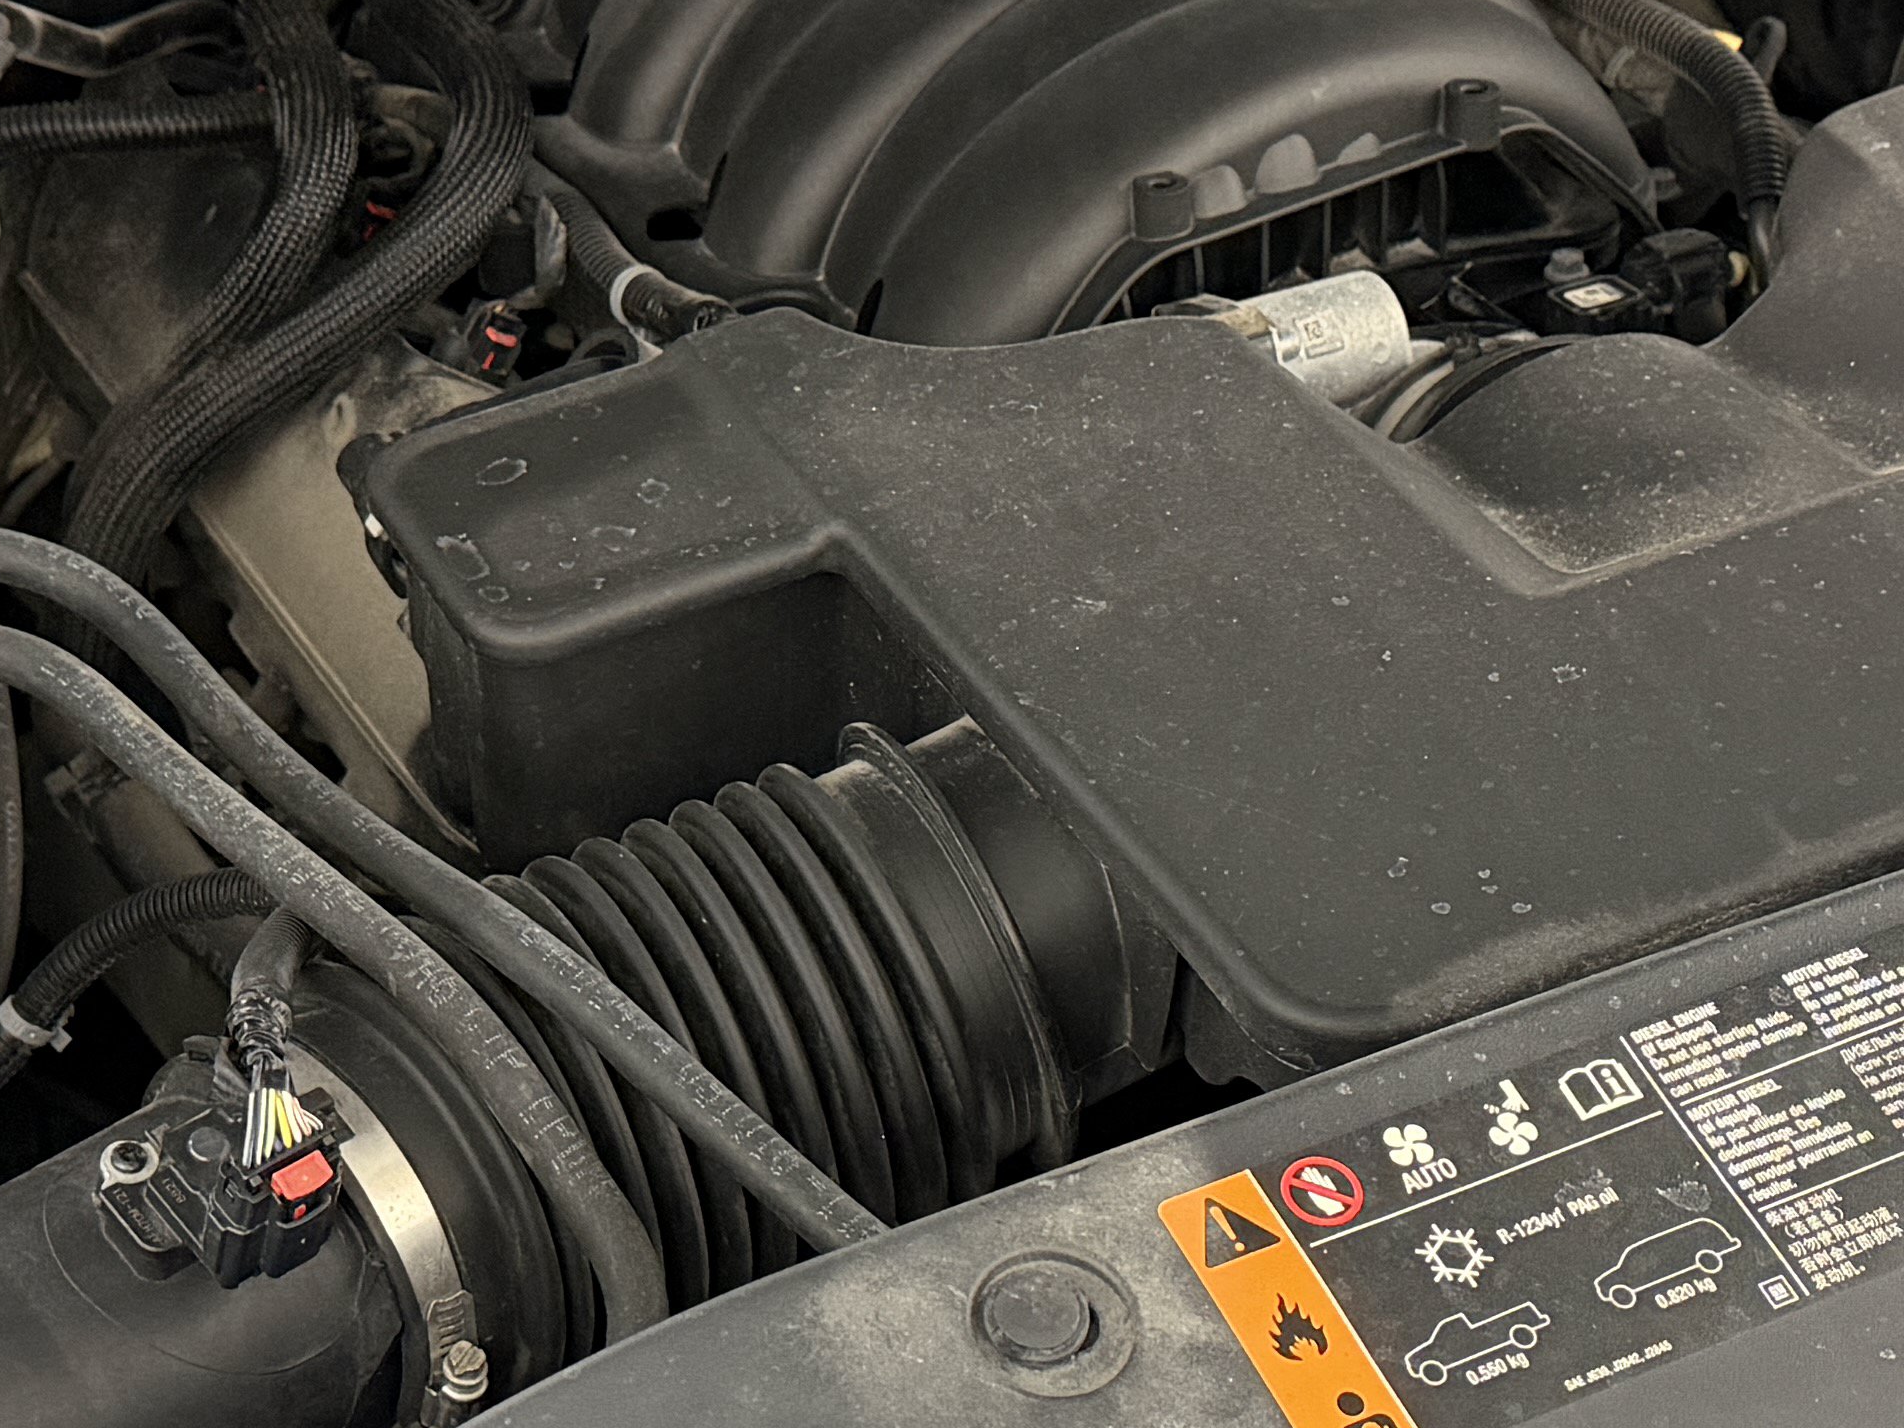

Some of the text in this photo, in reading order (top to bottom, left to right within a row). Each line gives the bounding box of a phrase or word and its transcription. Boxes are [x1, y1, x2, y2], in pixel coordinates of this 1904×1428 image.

[1780, 946, 1869, 986] MOTOR DIESEL
[1821, 965, 1860, 988] tiene)
[1800, 997, 1822, 1012] No
[1819, 990, 1844, 1006] use
[1840, 974, 1882, 997] fluidos
[1879, 968, 1898, 982] de
[1883, 1002, 1902, 1015] en
[1629, 1001, 1720, 1044] DIESEL ENGINE
[1809, 1011, 1831, 1025] Se
[1827, 994, 1874, 1021] pueden
[1648, 1009, 1793, 1071] Do not use starting fluids.
[1653, 1019, 1719, 1052] Equipped)
[1657, 1020, 1809, 1084] Immediate engine damage
[1668, 1065, 1732, 1098] can result.
[1685, 1077, 1782, 1122] MOTEUR DIESEL
[1858, 1073, 1880, 1088] Не
[1704, 1087, 1847, 1149] Ne pas utiliser de liquide
[1793, 1114, 1822, 1132] Des
[1399, 1156, 1458, 1194] AUTO
[1726, 1139, 1794, 1177] dommages
[1736, 1129, 1874, 1190] au moteur pourraient en
[1746, 1176, 1798, 1204] résulter.
[1763, 1186, 1843, 1228] 柴油发动机
[1494, 1185, 1619, 1246] R-1234yf PAG oil
[1653, 1272, 1718, 1309] 0.820 kg
[1464, 1351, 1530, 1386] 0.550 kg
[1563, 1374, 1587, 1391] SAE
